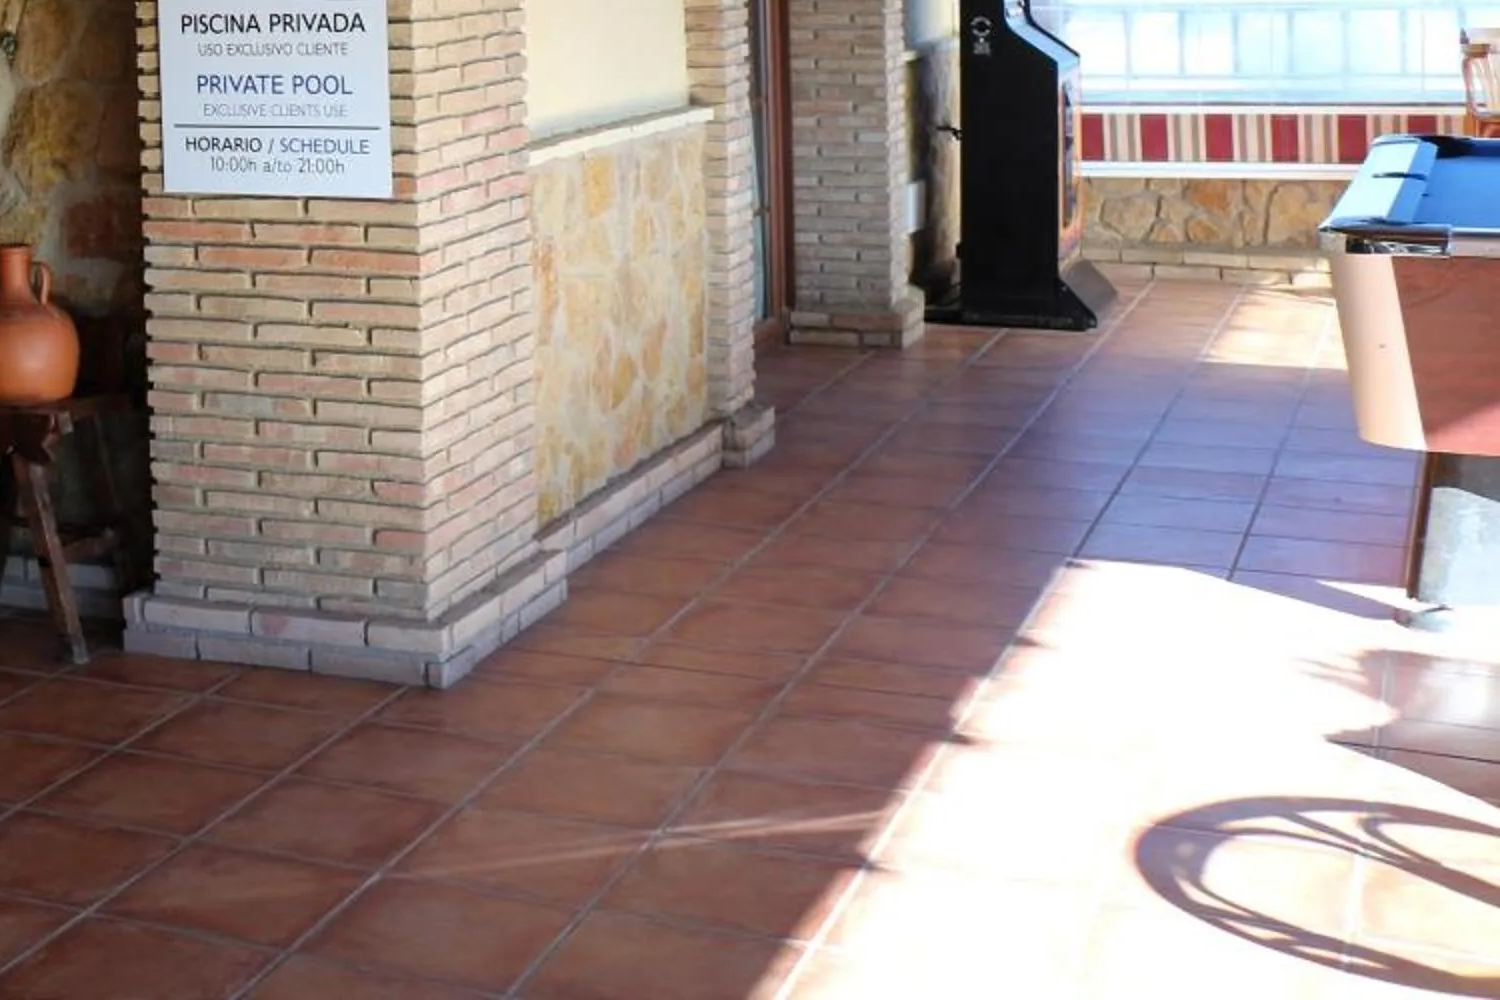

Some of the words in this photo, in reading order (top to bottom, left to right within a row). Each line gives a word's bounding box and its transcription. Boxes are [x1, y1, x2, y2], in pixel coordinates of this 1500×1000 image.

[180, 13, 261, 35] PISCINA
[268, 12, 366, 34] PRIVADA
[197, 42, 223, 57] USO
[226, 42, 293, 57] EXCLUSIVO
[297, 41, 349, 57] CLIENTE
[196, 74, 284, 95] PRIVATE
[292, 74, 353, 96] POOL
[203, 102, 267, 118] EXCLUSIVE
[271, 103, 321, 118] CLIENTS
[323, 103, 349, 118] USE
[184, 135, 262, 154] HORARIO
[279, 136, 371, 155] SCHEDULE
[211, 155, 257, 173] 10:00h
[298, 156, 345, 175] 21:00h
